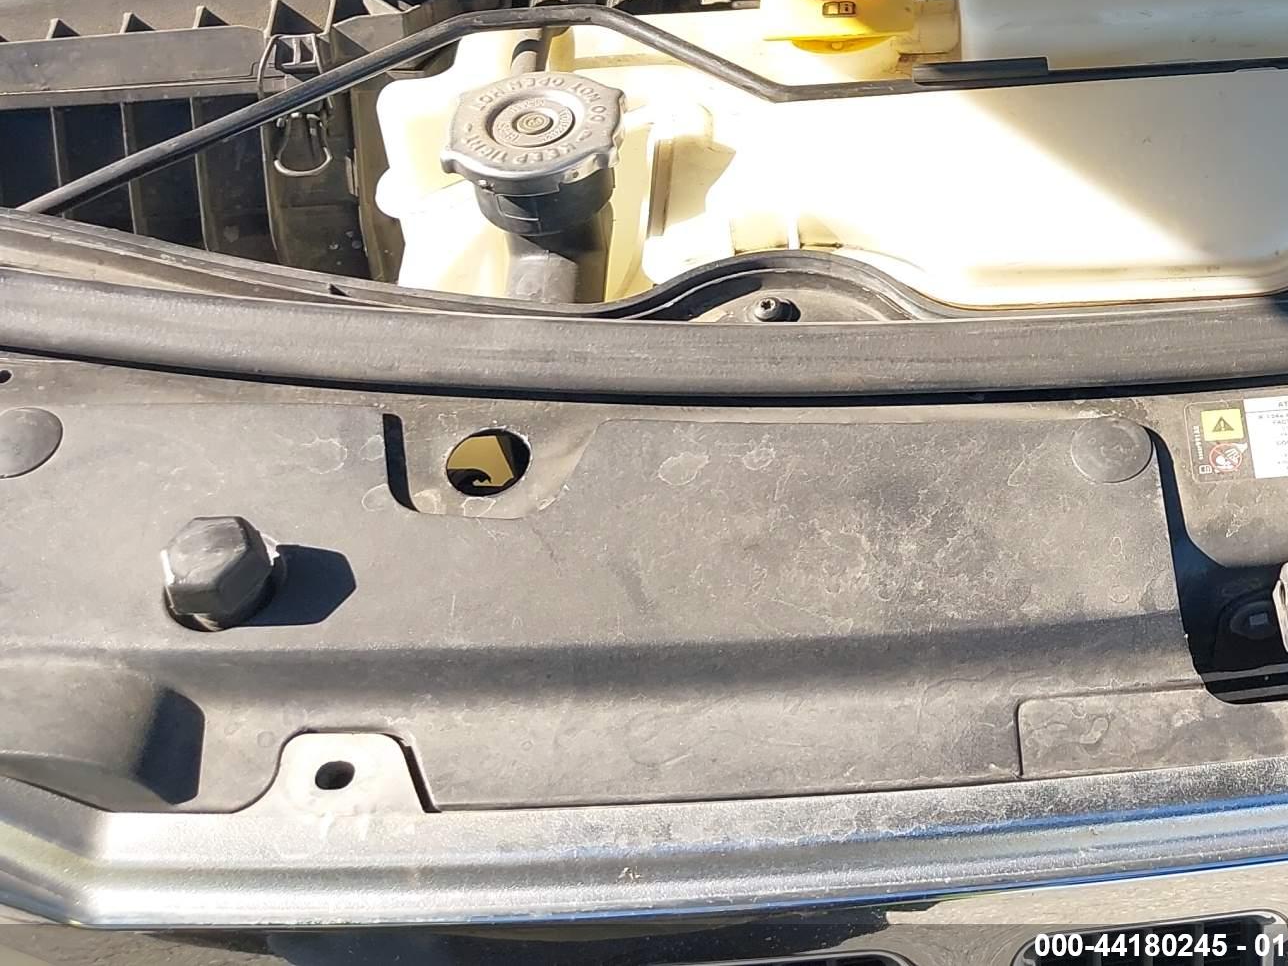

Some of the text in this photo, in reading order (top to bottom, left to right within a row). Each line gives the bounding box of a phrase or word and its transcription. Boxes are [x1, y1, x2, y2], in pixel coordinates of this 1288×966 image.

[510, 77, 565, 91] OPEN
[571, 83, 601, 103] NOT
[590, 105, 607, 122] DO
[514, 143, 576, 164] KEEP
